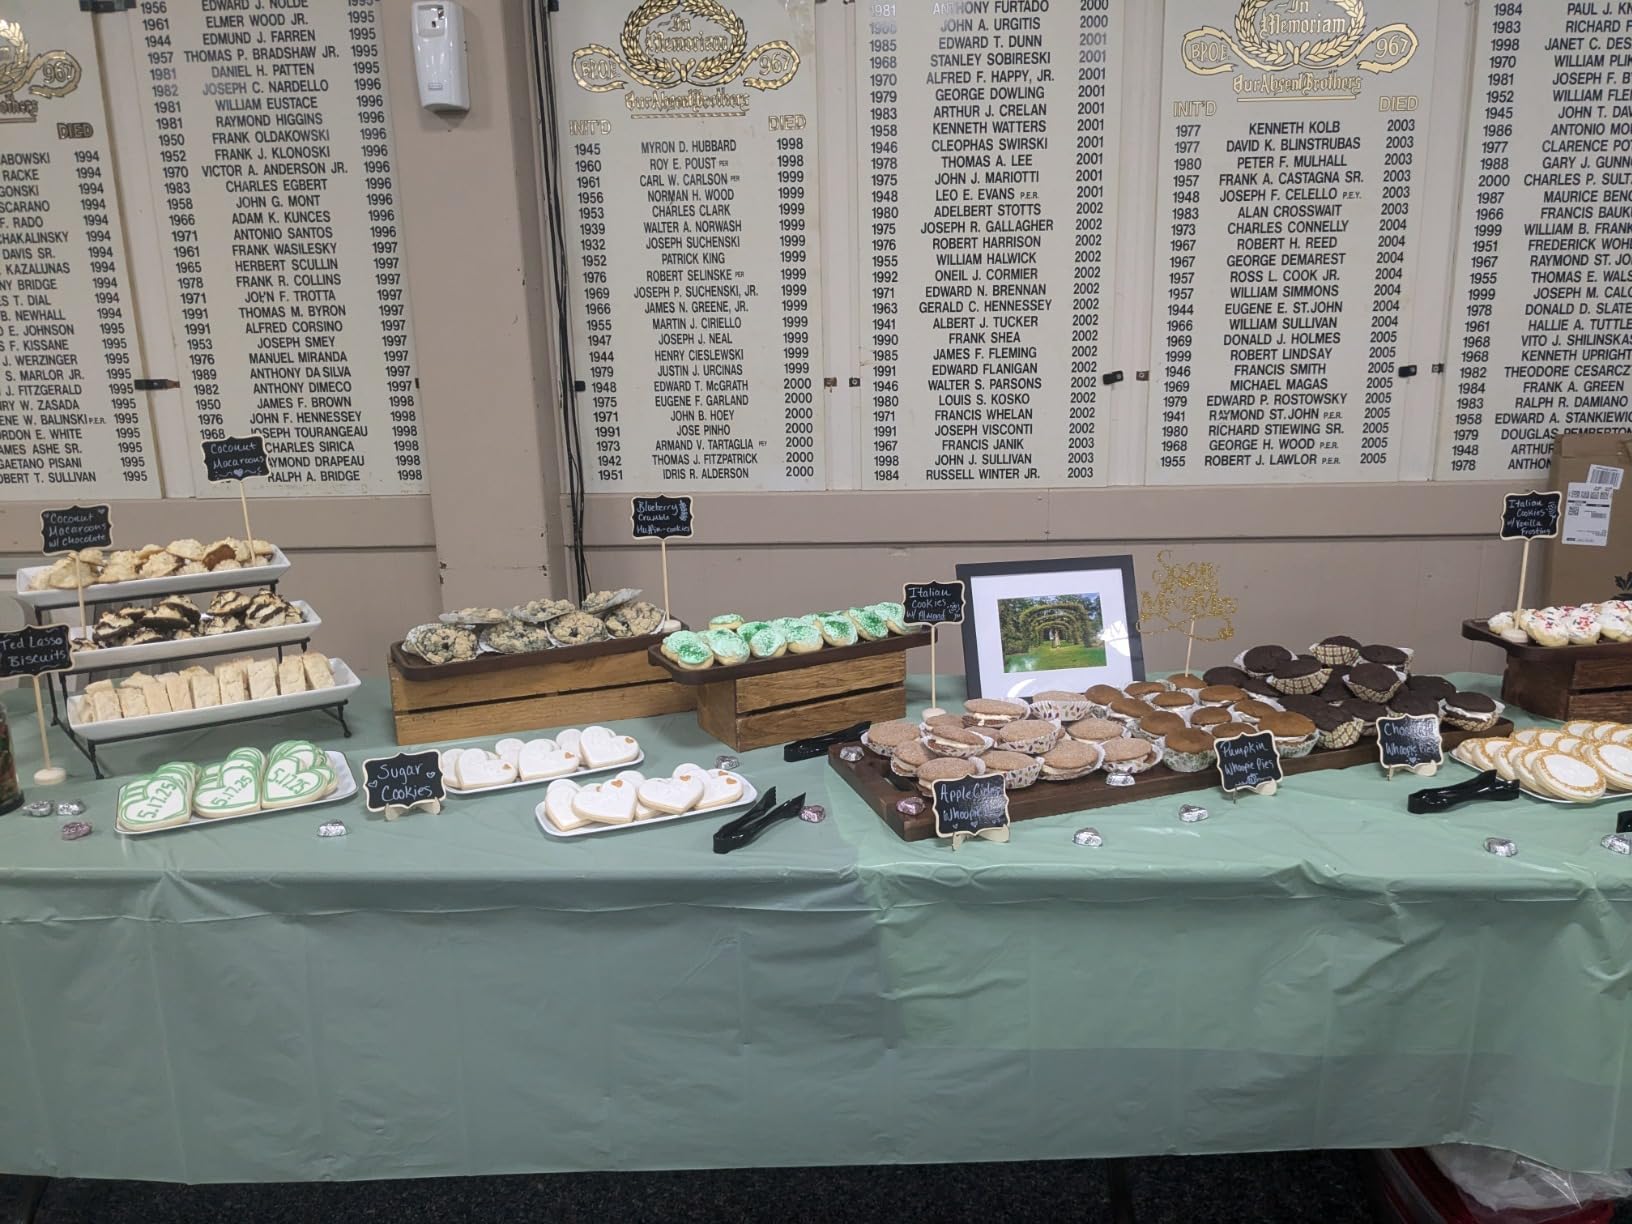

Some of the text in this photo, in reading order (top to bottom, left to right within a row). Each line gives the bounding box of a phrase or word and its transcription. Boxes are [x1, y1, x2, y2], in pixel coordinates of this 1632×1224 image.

[1260, 10, 1345, 39] Memoriam
[1375, 34, 1408, 58] 967
[42, 61, 73, 83] 967
[759, 53, 790, 75] 967
[870, 85, 1104, 103] 1979 GEORGE DOWLING 2001
[154, 95, 383, 113] 1981 WILLIAM EUSTACE 1996
[1379, 95, 1419, 112] DIED
[57, 122, 94, 139] DIED
[768, 114, 806, 131] DIED
[871, 119, 1104, 137] 1958 KENNETH WATTERS 2001
[1176, 118, 1415, 137] 1977 KENNETH KOLB 2003
[1484, 123, 1605, 136] 1986 ANTONIO
[158, 128, 386, 146] 1950 FRANK OLDAKOWSKI 1996
[1482, 140, 1608, 153] 1977 CLARENCE
[76, 167, 101, 178] 1994
[164, 177, 391, 194] 1983 CHARLES EGBERT 1996
[579, 203, 804, 219] 1953 CHARLES CLARK 1999
[872, 202, 1103, 218] 1980 ADELBERT STOTTS 2002
[1172, 203, 1408, 220] 1983 ALAN CROSSWAIT 2003
[2, 246, 113, 260] DAVIS SR. 1994
[174, 242, 397, 257] 1961 FRANK WASILESKY 1997
[582, 250, 806, 266] 1952 PATRICK KING 1999
[6, 261, 115, 274] KAZALUNAS 1994
[1168, 284, 1400, 300] 1957 WILLIAM SIMMONS 2004
[873, 330, 1098, 345] 1990 FRANK SHEA 2002
[15, 353, 129, 366] WERZINGER 1995
[589, 347, 808, 362] 1944 HENRY CIESLEWSKI 1999
[1462, 349, 1632, 362] 1968 KENNETH UPRIGHT
[1165, 362, 1394, 377] 1946 FRANCIS SMITH 2005
[1460, 367, 1486, 378] 1982
[1504, 366, 1569, 377] THEODORE
[18, 383, 134, 395] FITZGERALD 1995
[592, 378, 811, 393] 1948 EDWARD T. McGRATH 2000
[1458, 381, 1624, 394] 1984 FRANK A. GREEN
[210, 442, 256, 454] Coconut
[213, 456, 264, 470] Macaroons
[1161, 456, 1185, 467] 1955
[1205, 455, 1251, 466] ROBERT
[1256, 455, 1264, 465] J.
[1270, 454, 1317, 465] LAWLOR
[1360, 453, 1386, 464] 2005
[637, 500, 679, 516] Blueberry
[1508, 500, 1542, 508] Italian
[50, 512, 94, 524] Coconut
[1517, 509, 1545, 517] Cookies
[49, 523, 106, 537] Macaroons
[908, 586, 951, 598] Italian
[912, 599, 946, 608] Cookies
[0, 636, 63, 650] Ted Lasso
[7, 649, 66, 667] Biscuits
[1220, 741, 1268, 757] Pumpkin
[377, 763, 423, 784] Sugar
[1224, 757, 1274, 775] Whoopie Pies
[211, 775, 252, 807] 5.17.25
[381, 785, 432, 801] Cookies
[940, 784, 971, 803] Apple
[137, 783, 177, 818] 5.17.25
